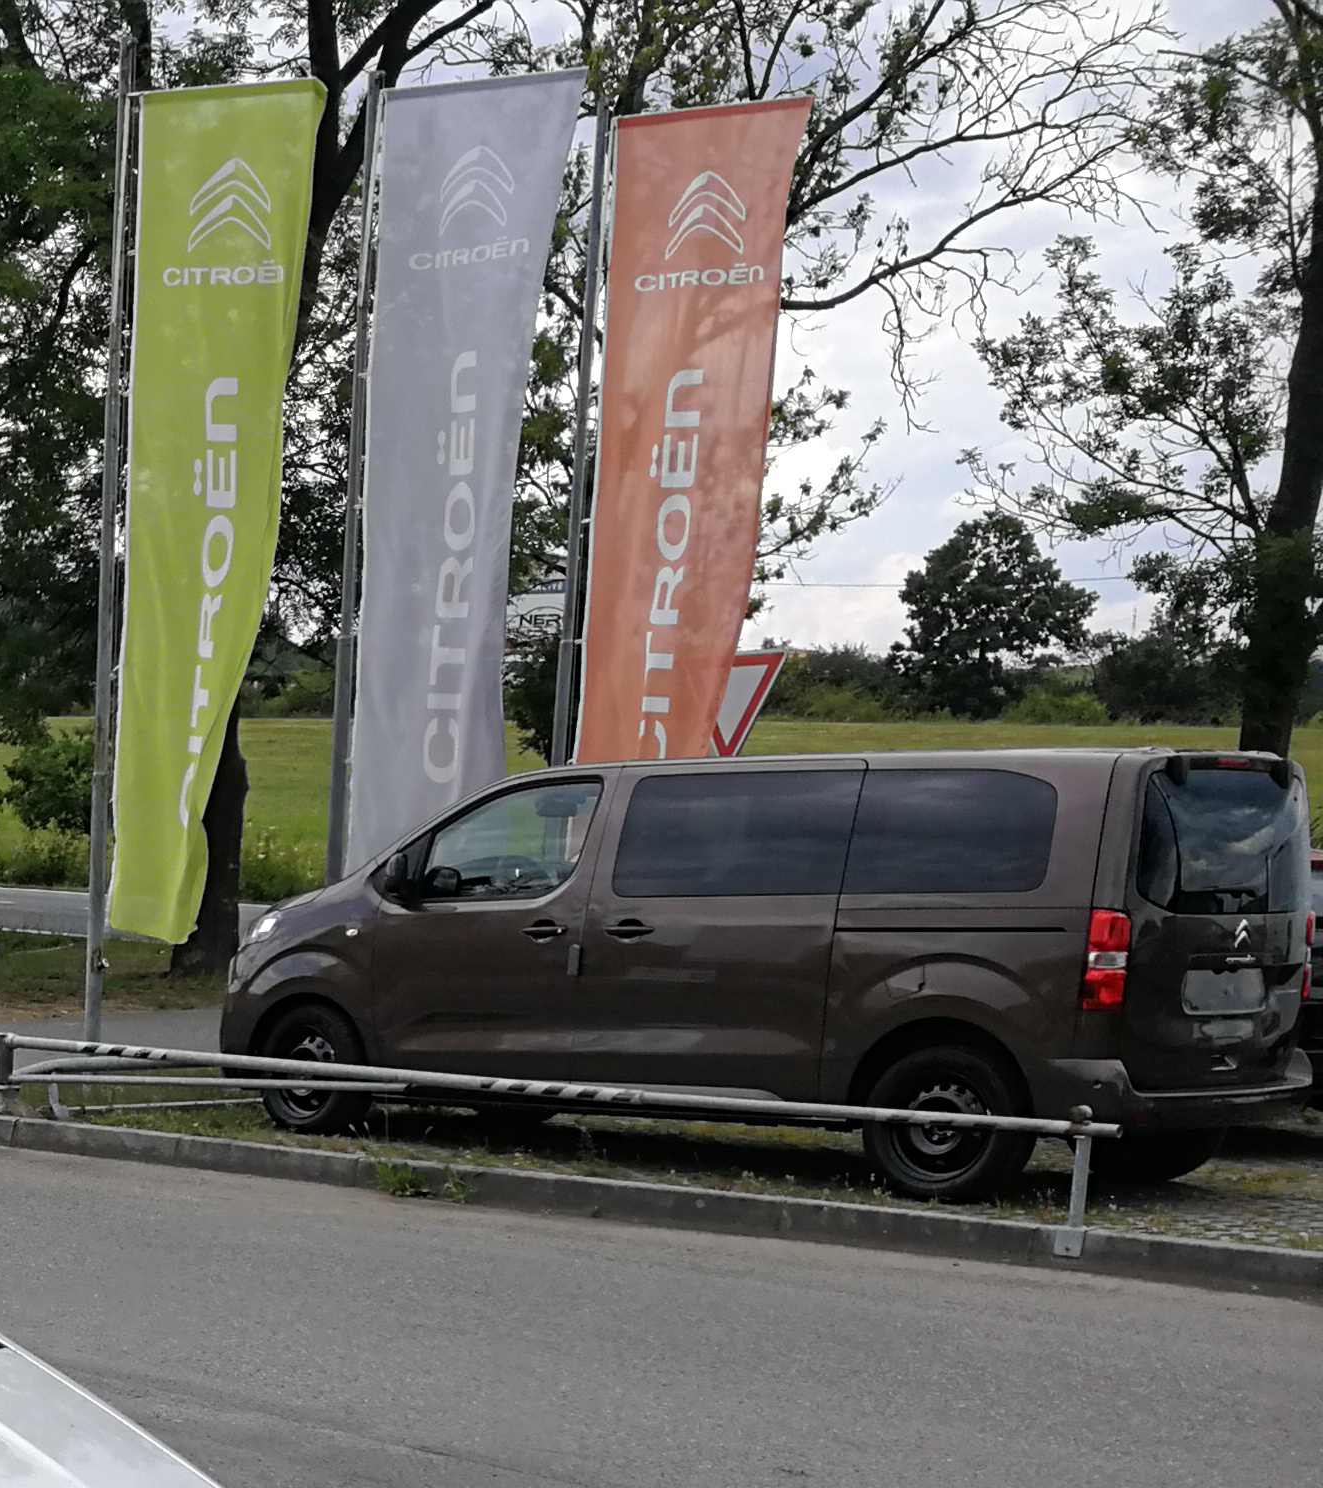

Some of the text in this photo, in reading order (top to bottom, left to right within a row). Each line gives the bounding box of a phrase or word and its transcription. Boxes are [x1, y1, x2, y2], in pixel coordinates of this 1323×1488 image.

[408, 236, 530, 271] CITROËN
[634, 263, 764, 292] CITROËN
[422, 351, 477, 784] CITROËN
